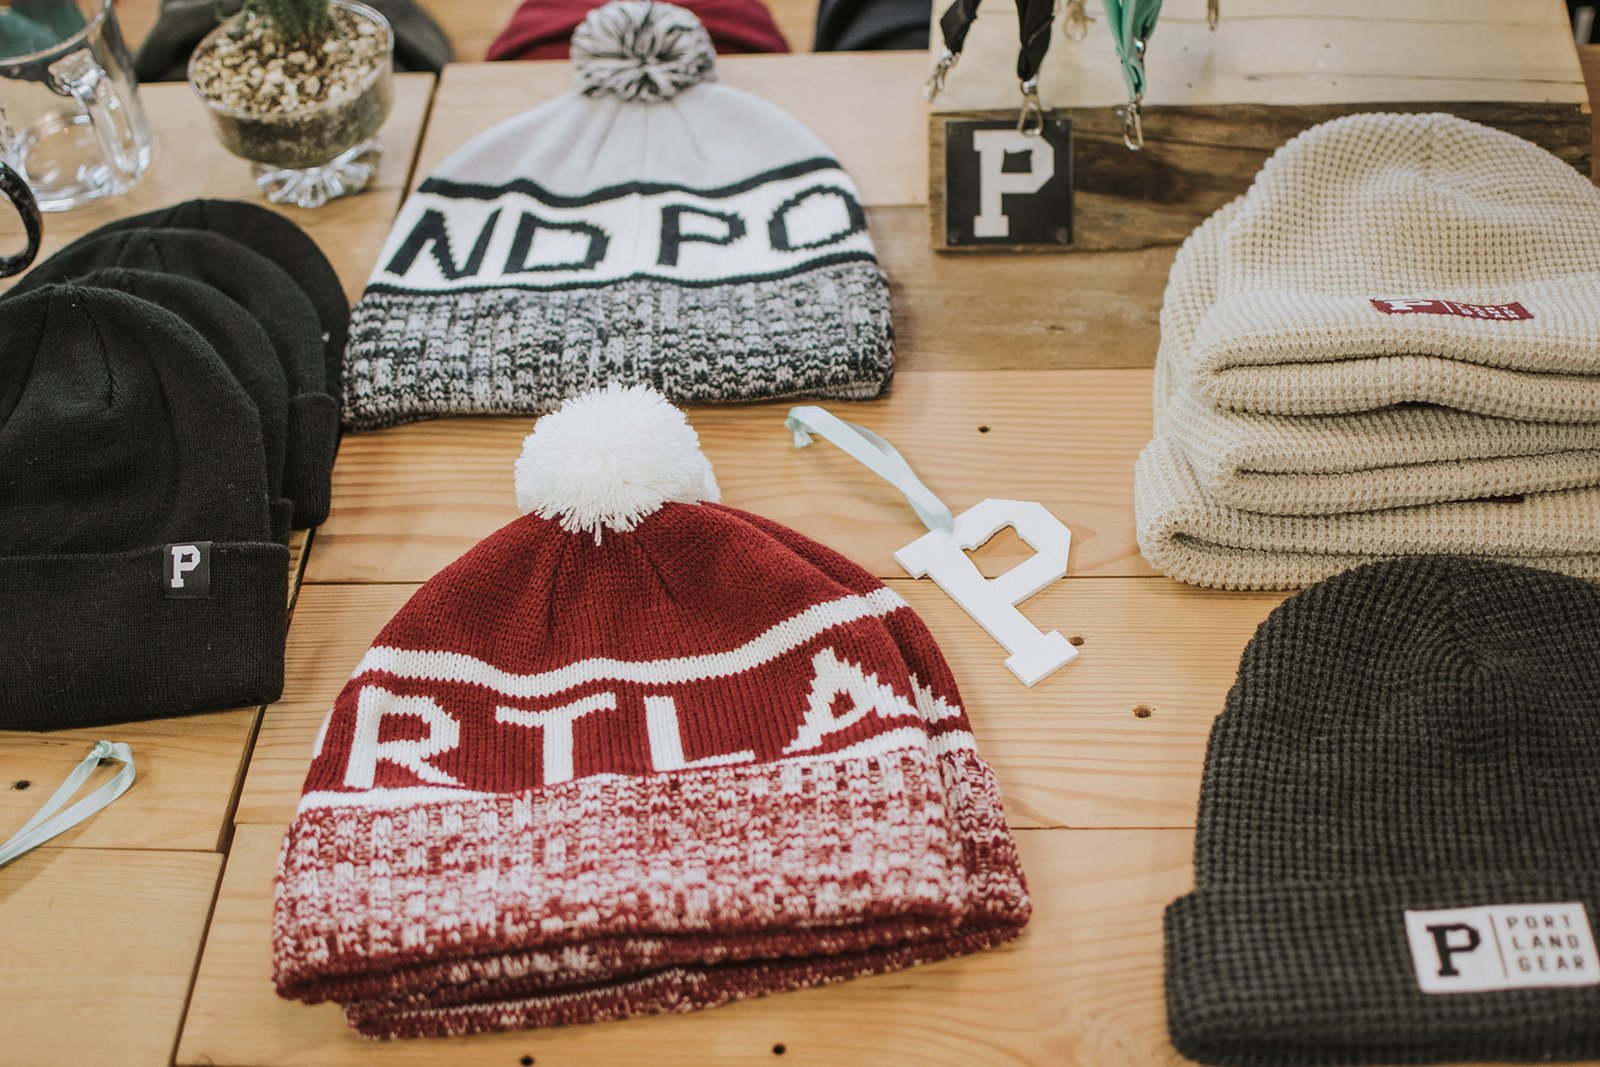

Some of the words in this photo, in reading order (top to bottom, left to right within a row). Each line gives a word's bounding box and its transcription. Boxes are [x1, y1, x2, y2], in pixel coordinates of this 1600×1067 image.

[973, 129, 1054, 237] P
[171, 545, 201, 588] P
[894, 498, 1080, 688] P
[312, 646, 922, 788] RTLA
[1506, 914, 1571, 930] PORT
[1512, 934, 1580, 951] LAND
[1425, 922, 1482, 978] P
[1518, 956, 1586, 972] GEAR
